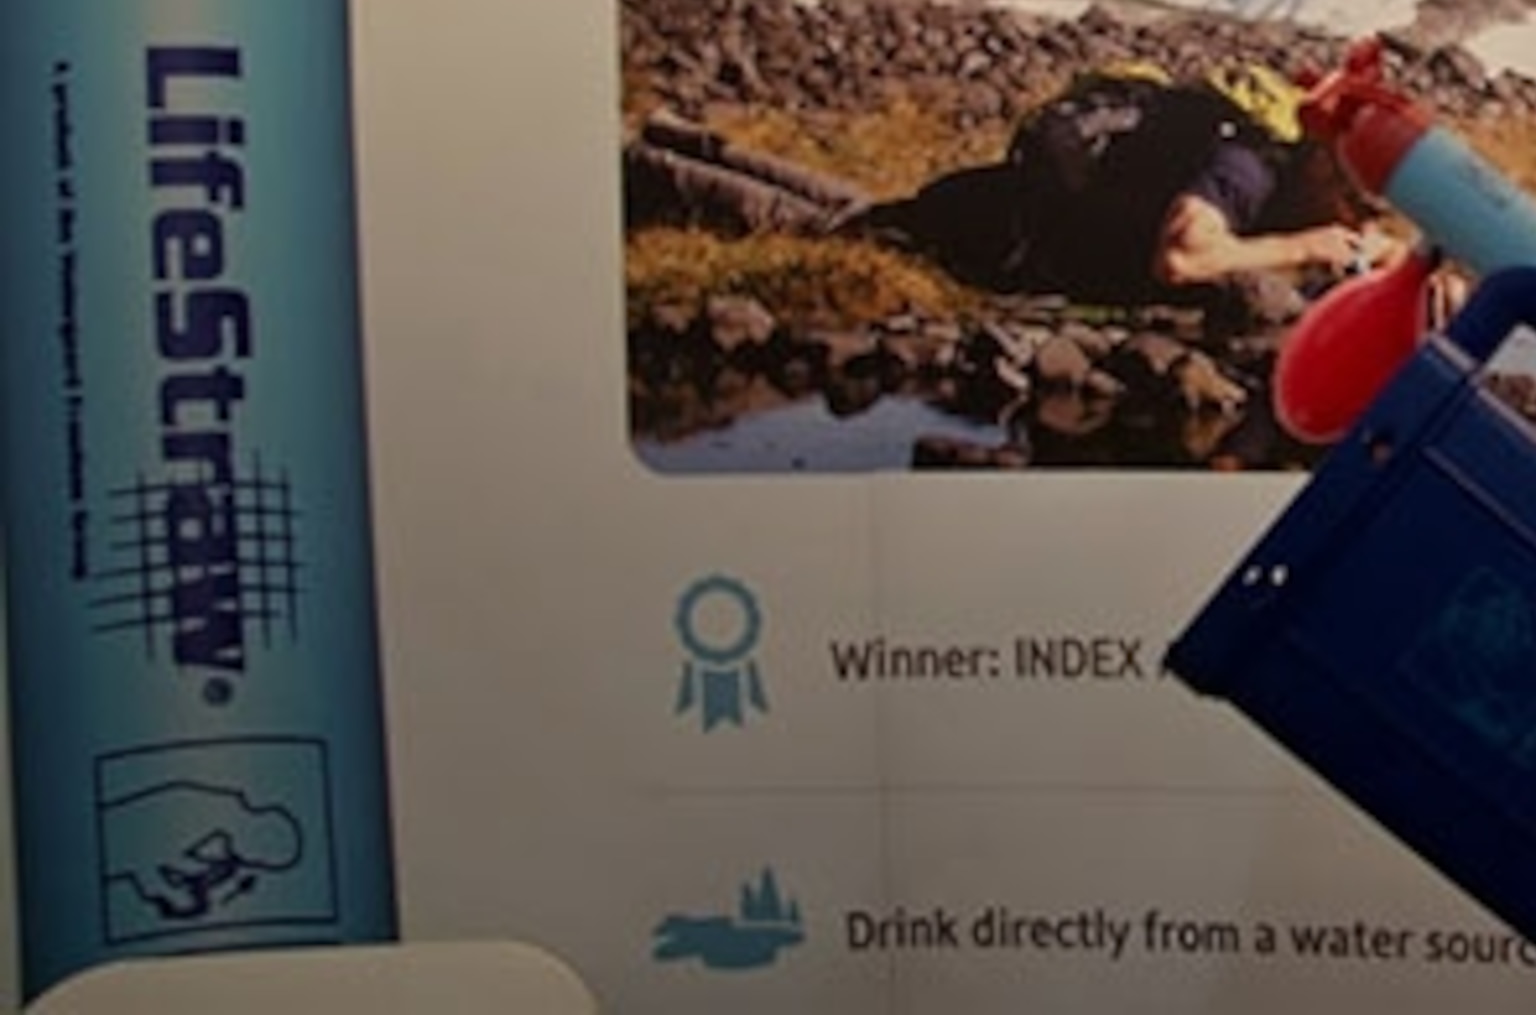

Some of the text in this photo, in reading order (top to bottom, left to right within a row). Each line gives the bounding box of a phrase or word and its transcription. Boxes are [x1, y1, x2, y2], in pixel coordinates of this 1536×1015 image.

[830, 635, 1000, 682] Winner:
[1014, 637, 1145, 679] INDEX
[846, 906, 957, 950] Drink
[972, 906, 1131, 962] directly
[1145, 909, 1239, 953] from
[1253, 920, 1277, 955] a
[1290, 919, 1412, 960] water
